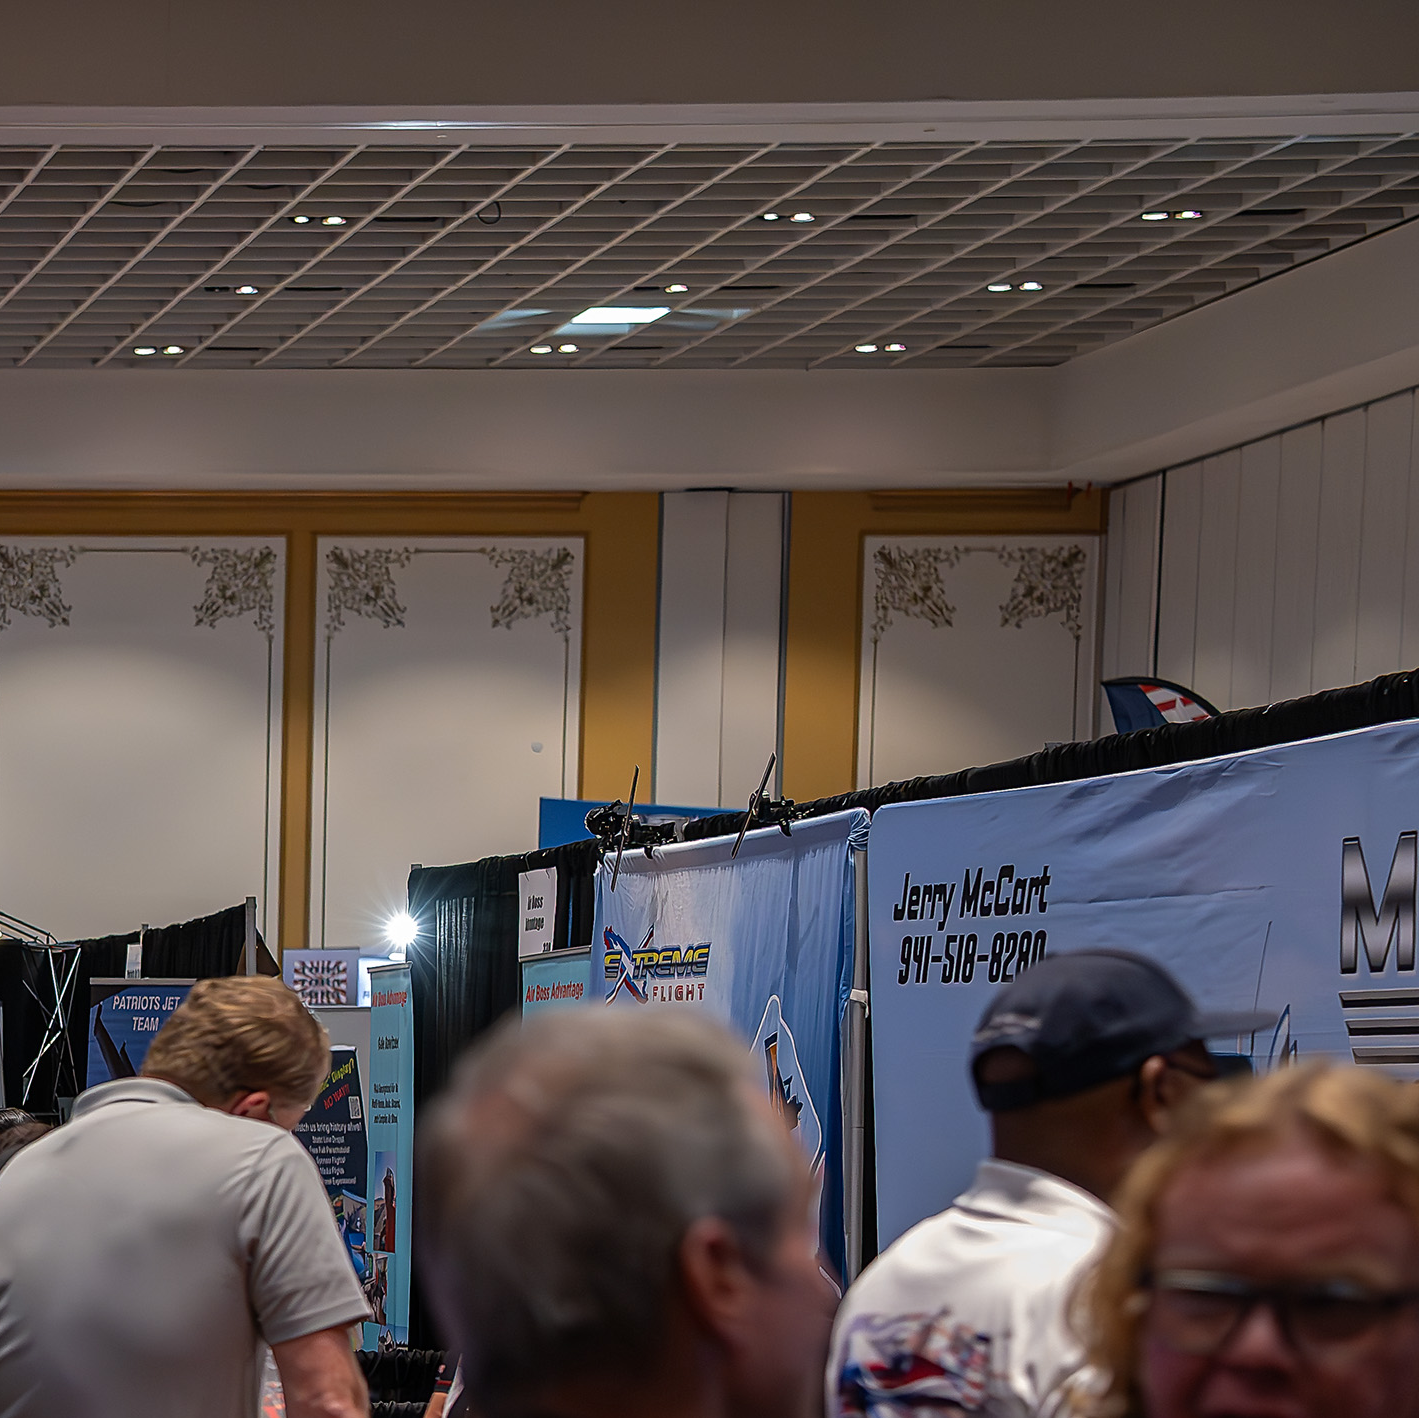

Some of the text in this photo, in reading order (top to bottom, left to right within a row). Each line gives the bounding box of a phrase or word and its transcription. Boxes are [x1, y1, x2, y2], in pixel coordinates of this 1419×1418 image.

[893, 865, 1051, 931] Jerry McCart
[898, 930, 1048, 985] 941-518-8280
[525, 980, 584, 1003] Air Boss Advantage
[652, 984, 705, 1002] FLIGHT
[112, 995, 181, 1011] PATRIOTS JET
[132, 1016, 160, 1032] TEAM
